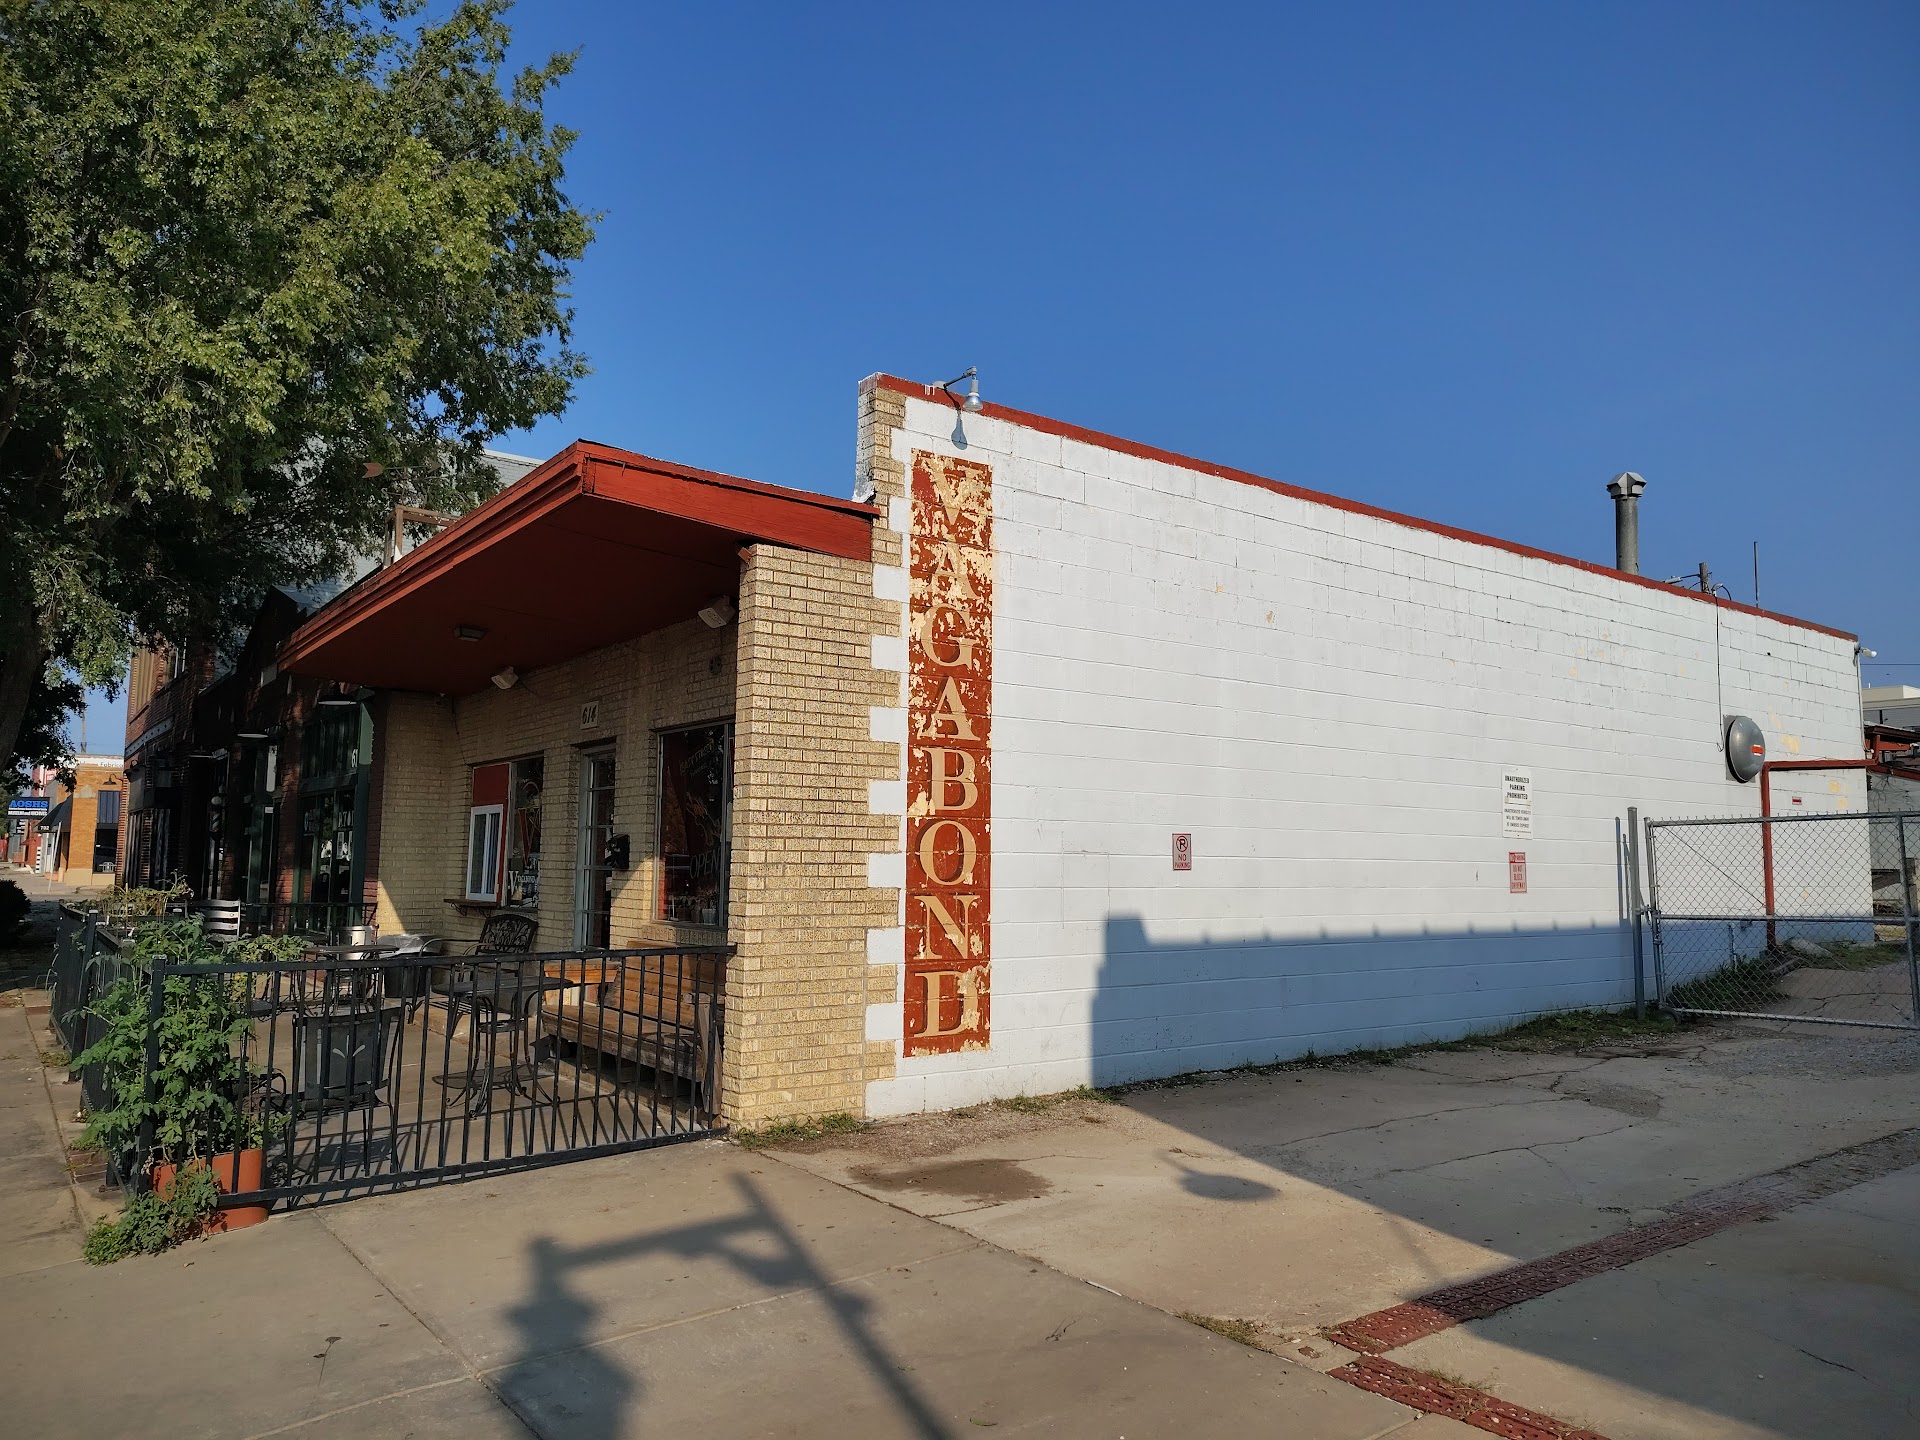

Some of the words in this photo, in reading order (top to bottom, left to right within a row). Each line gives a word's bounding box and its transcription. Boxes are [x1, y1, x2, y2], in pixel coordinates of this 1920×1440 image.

[582, 704, 598, 724] 614
[911, 456, 985, 1038] VAGABOND
[689, 846, 720, 880] OPEN
